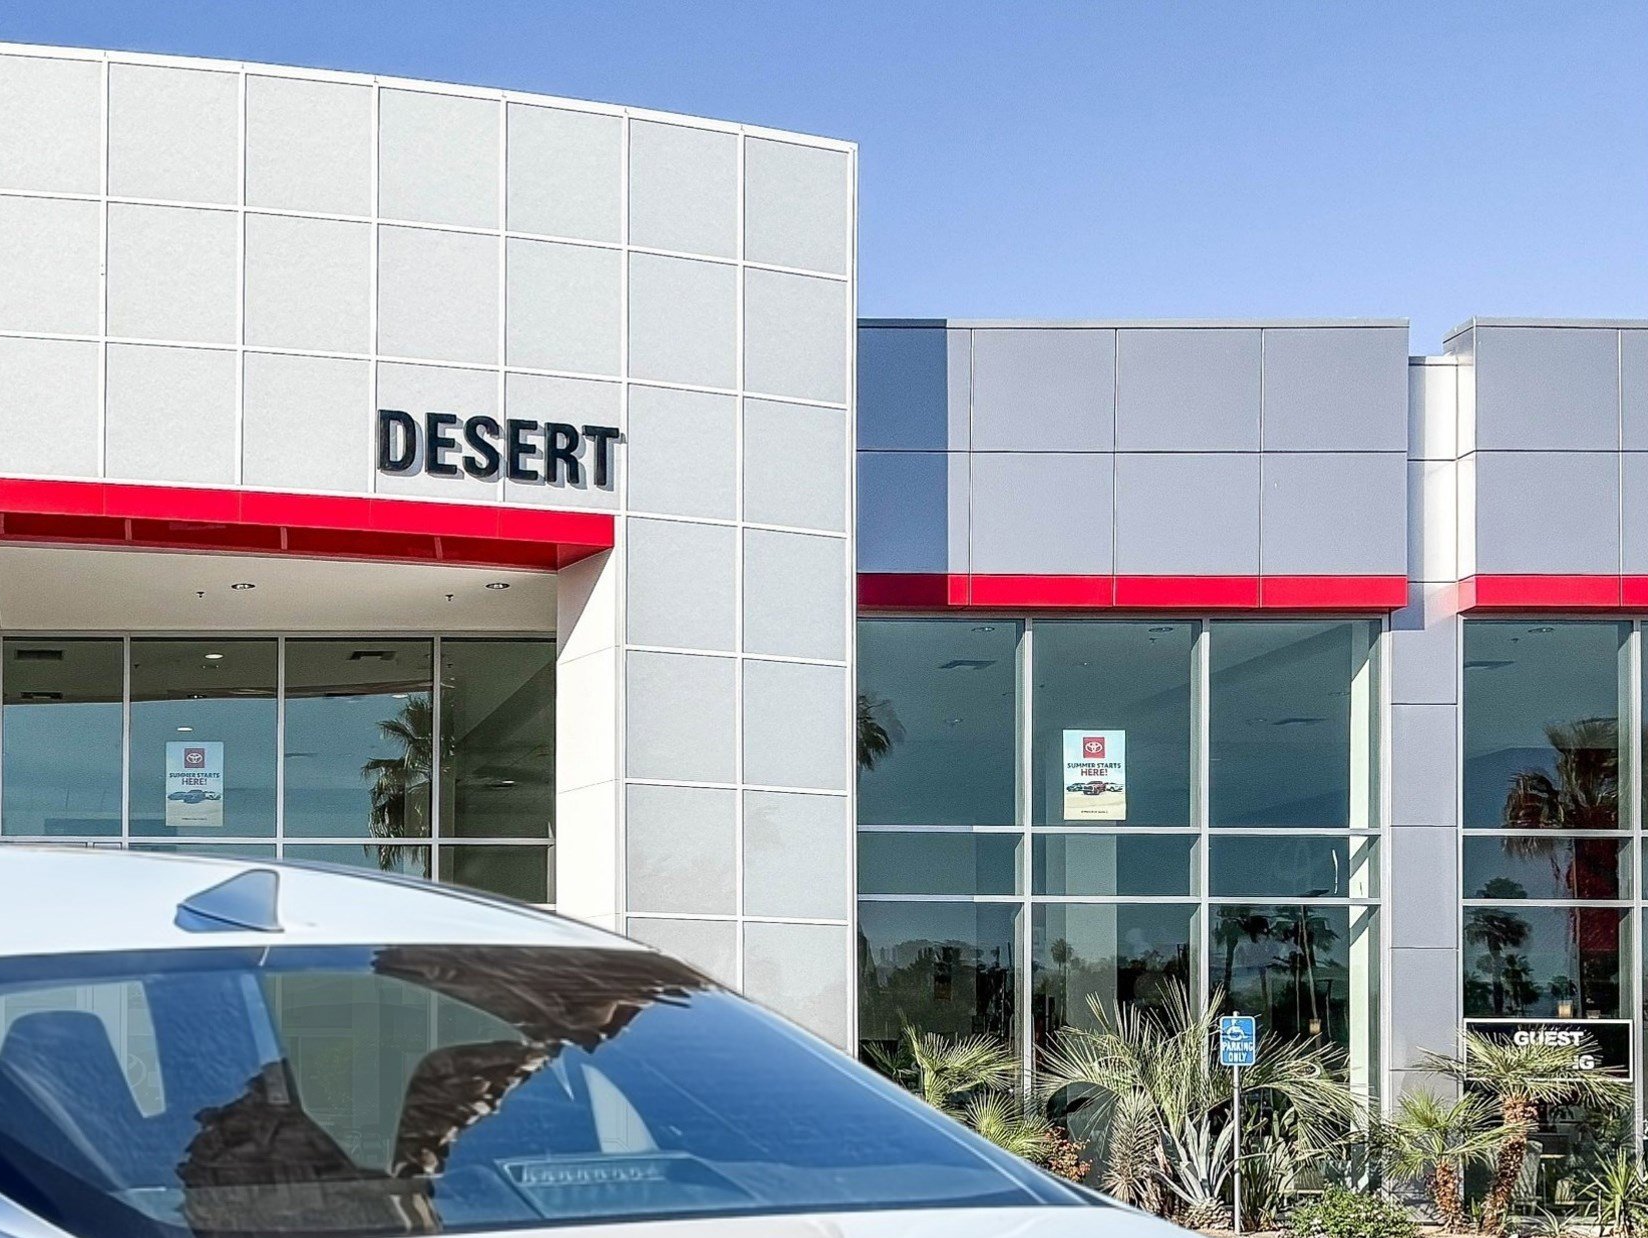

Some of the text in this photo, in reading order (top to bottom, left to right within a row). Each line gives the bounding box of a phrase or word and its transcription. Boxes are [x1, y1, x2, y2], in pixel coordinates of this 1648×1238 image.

[377, 409, 620, 486] DESERT
[1081, 768, 1108, 776] HERE!
[181, 777, 208, 786] HERE!
[1513, 1030, 1585, 1047] GUEST
[1222, 1041, 1253, 1052] PARKING
[1228, 1051, 1248, 1063] ONLY
